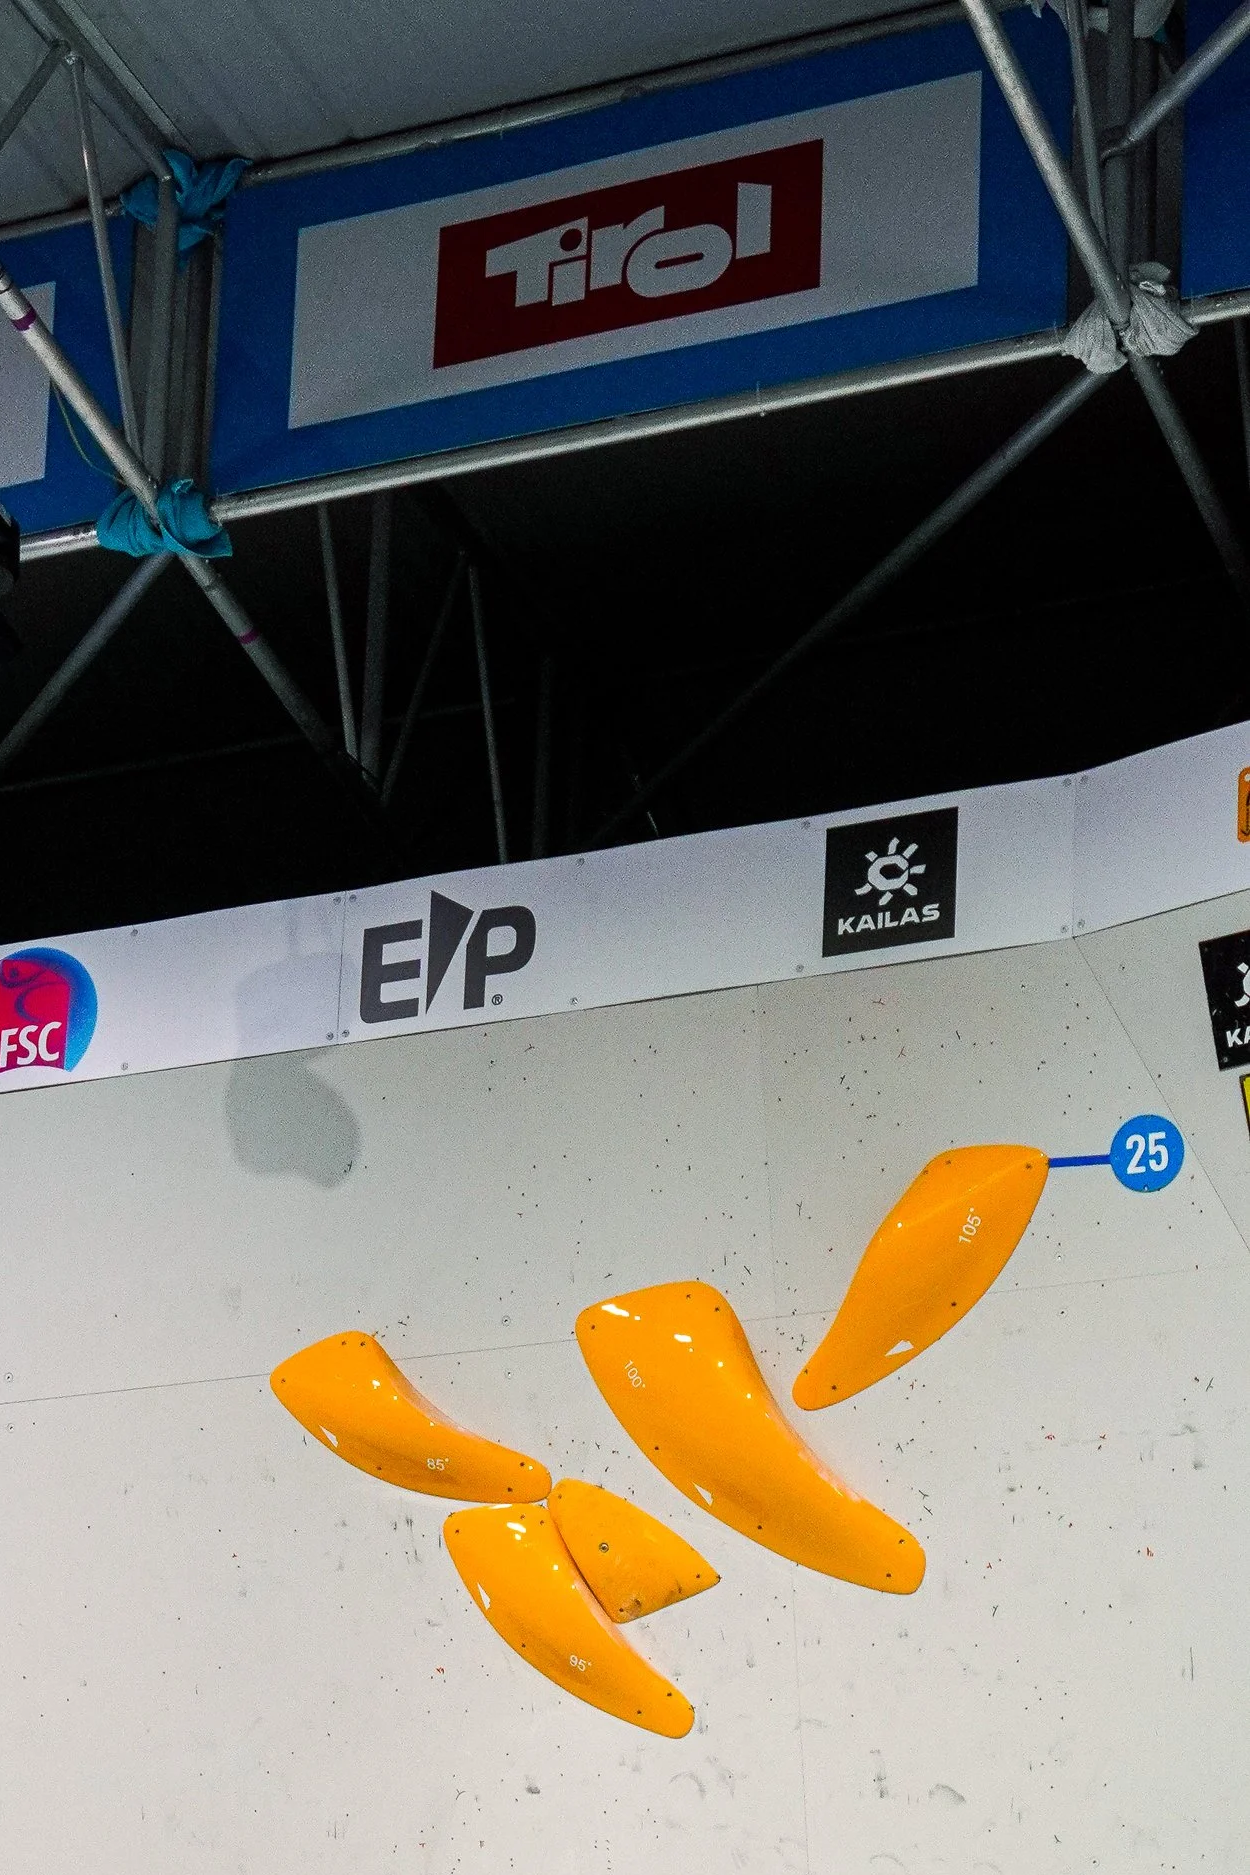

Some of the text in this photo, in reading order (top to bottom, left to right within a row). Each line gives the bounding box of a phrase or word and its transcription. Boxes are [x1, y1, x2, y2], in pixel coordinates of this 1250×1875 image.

[485, 181, 772, 308] Tirol
[836, 903, 940, 936] KAILAS
[1125, 1131, 1170, 1175] 25
